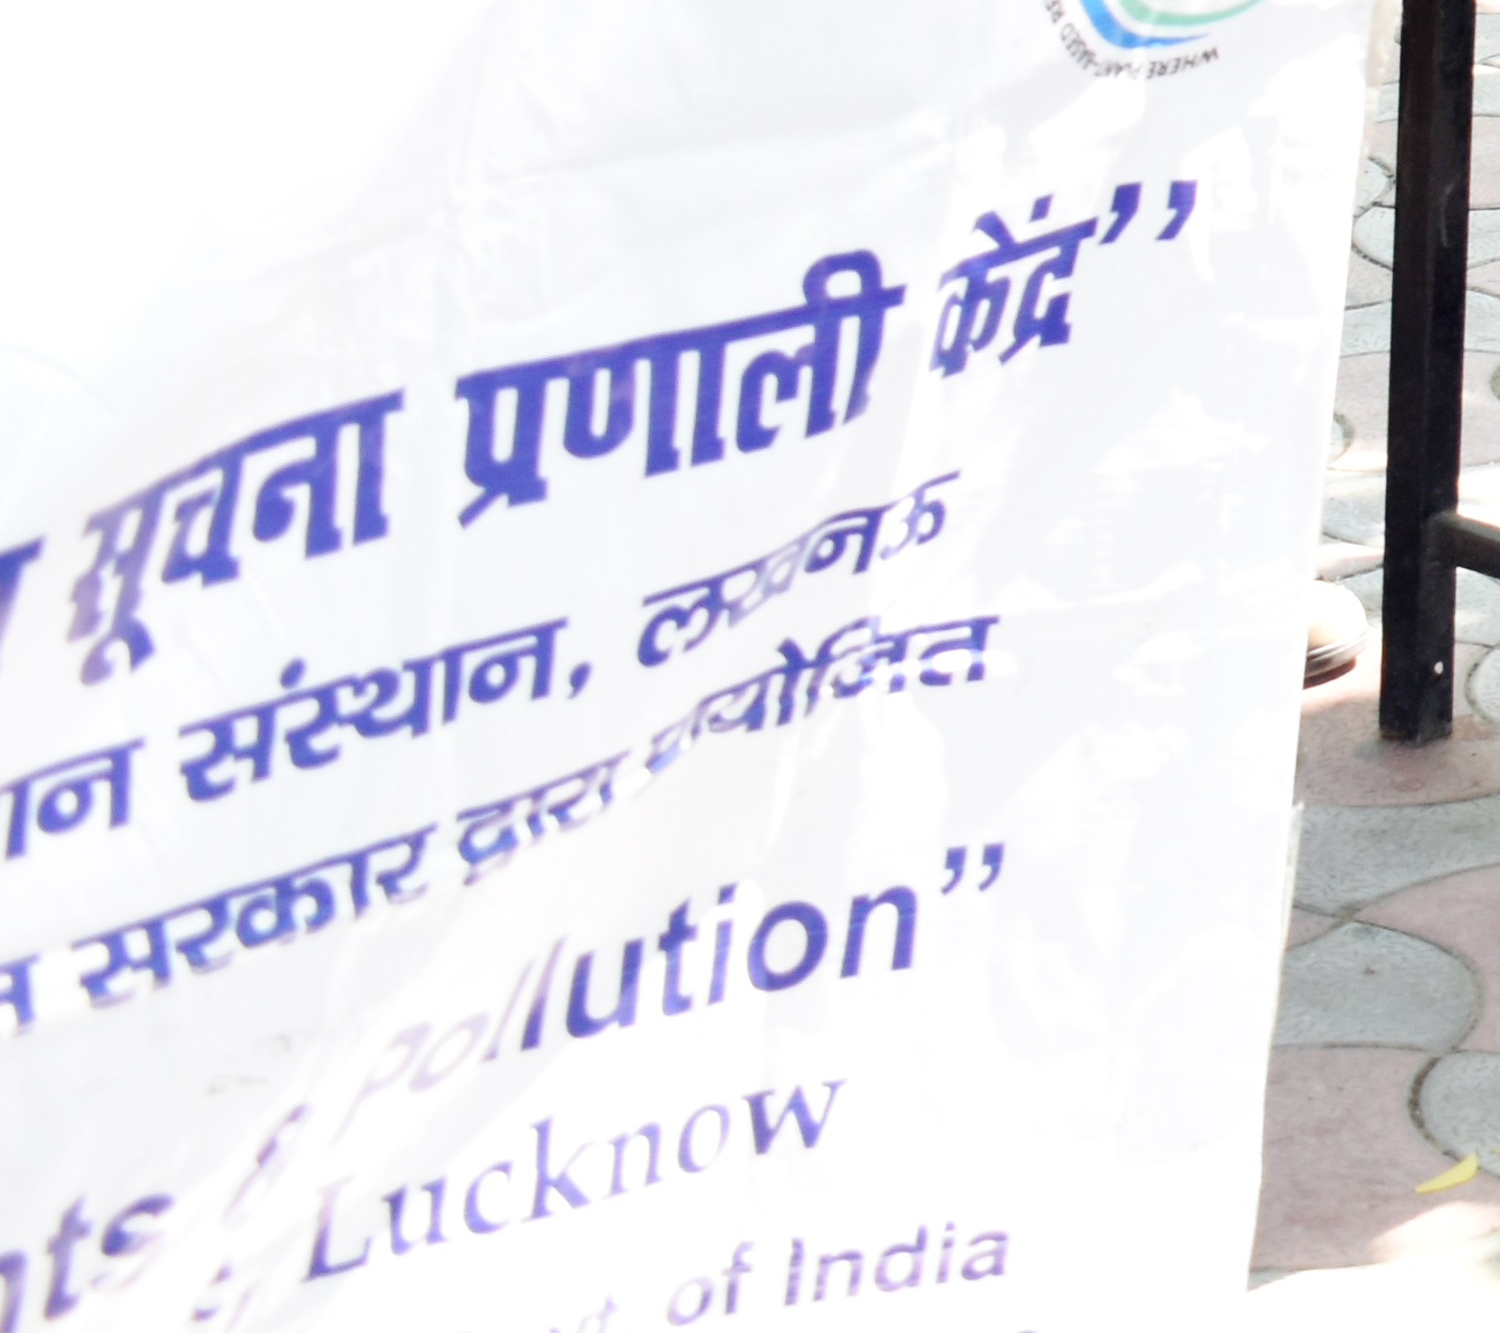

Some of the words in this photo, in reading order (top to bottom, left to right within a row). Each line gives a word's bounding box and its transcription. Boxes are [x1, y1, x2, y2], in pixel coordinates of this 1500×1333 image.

[64, 385, 406, 687] सूचना
[454, 247, 907, 529] प्रणाली
[177, 615, 594, 804] संस्थान,
[635, 470, 962, 668] लखनऊ
[71, 822, 439, 1010] सरकार
[301, 1078, 847, 1285] Lucknow
[666, 1240, 757, 1328] of
[784, 1221, 1011, 1310] India
